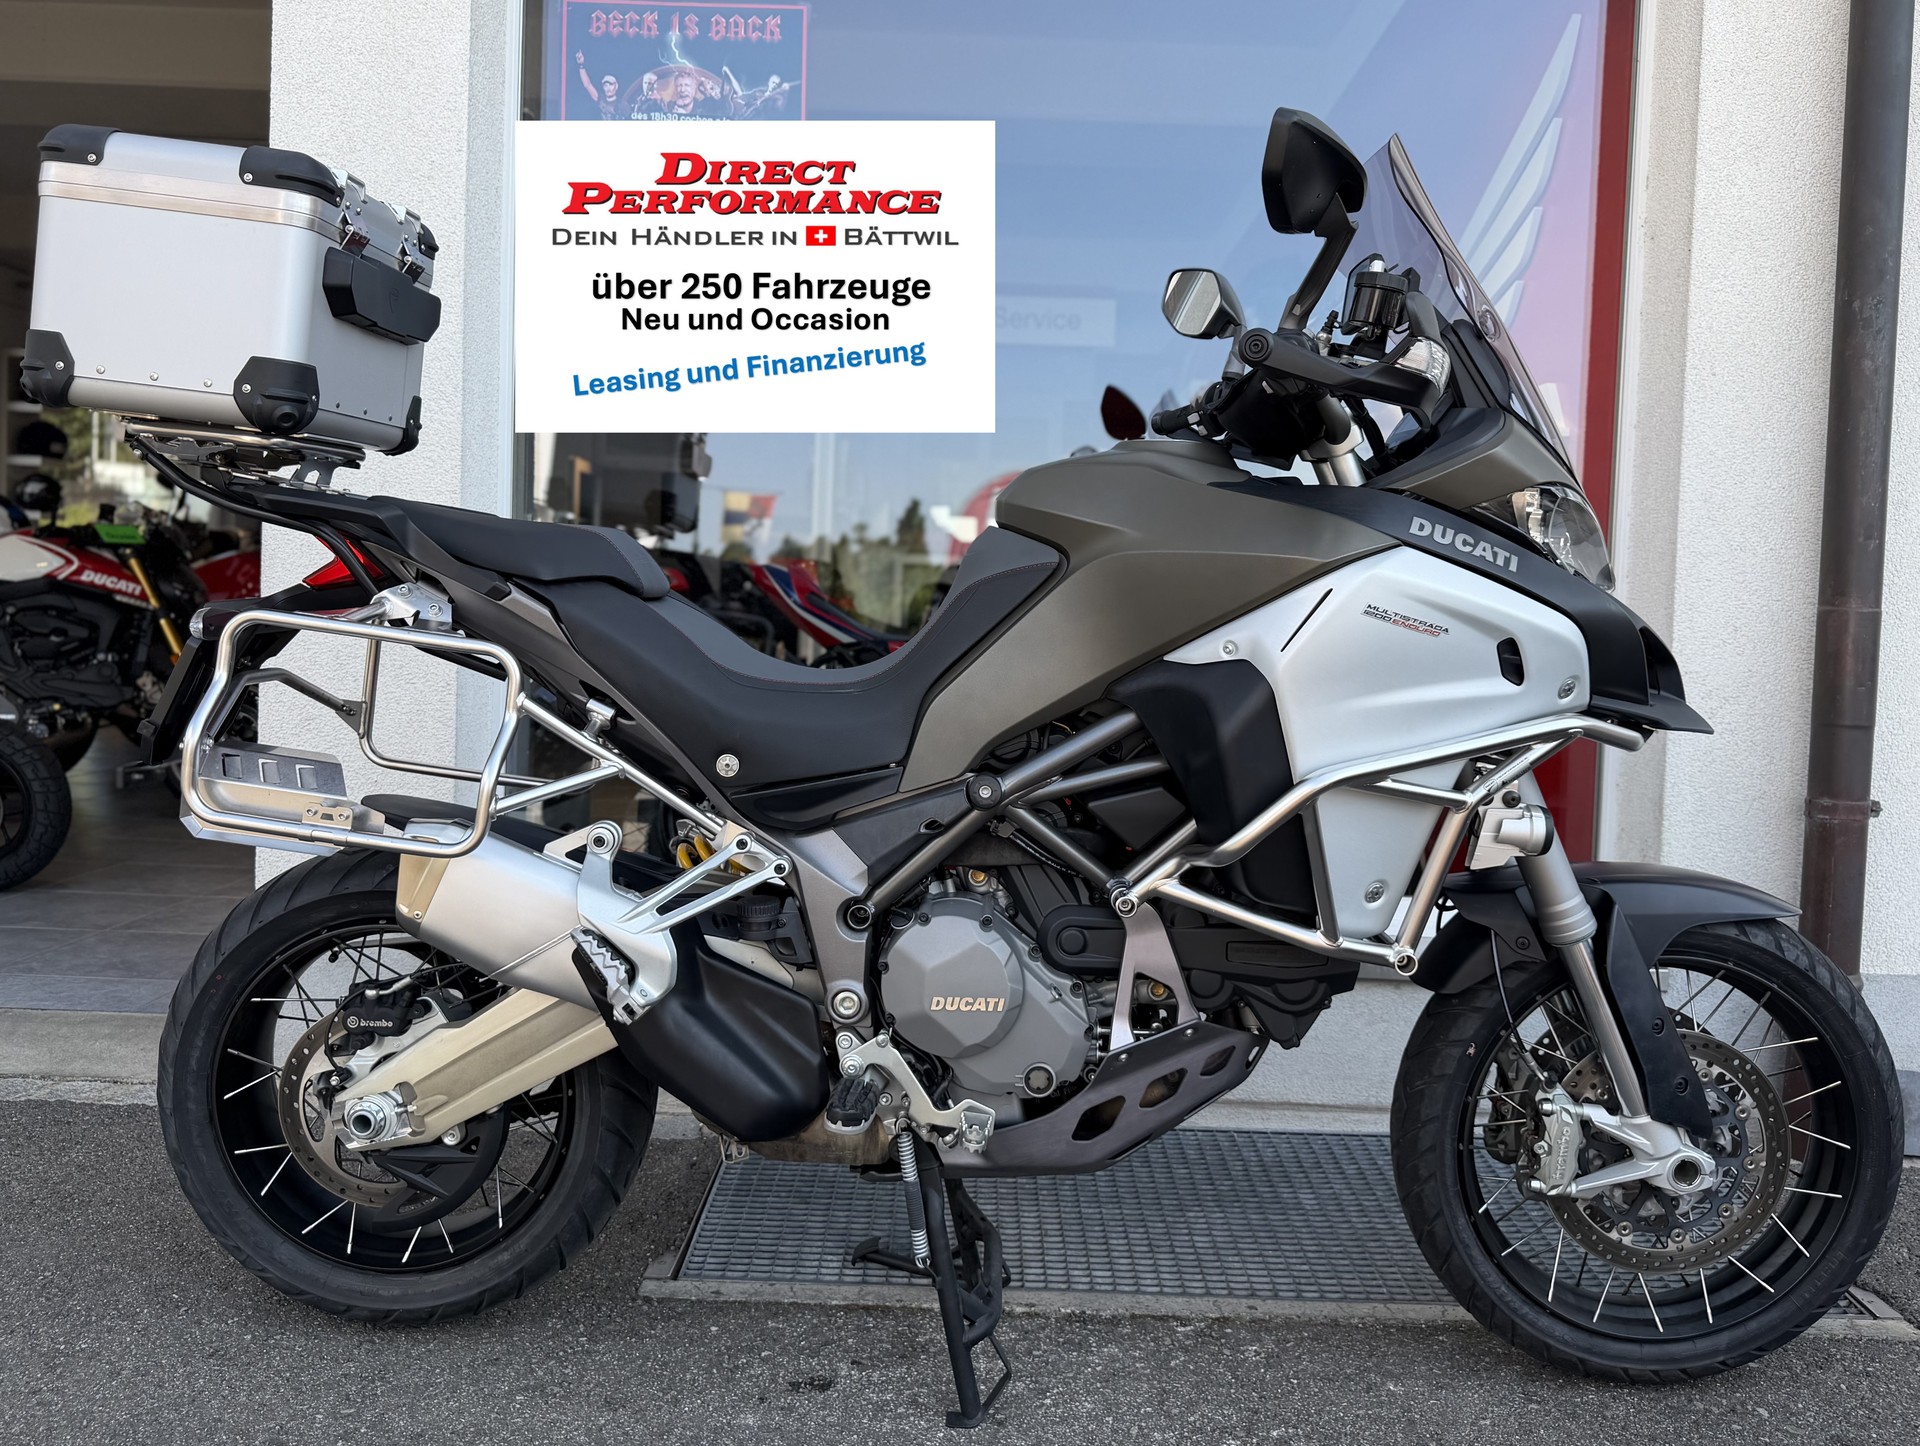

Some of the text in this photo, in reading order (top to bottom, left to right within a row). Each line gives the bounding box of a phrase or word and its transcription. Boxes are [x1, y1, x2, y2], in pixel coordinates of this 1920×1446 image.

[589, 9, 782, 41] BECK IS BACK
[1409, 516, 1519, 573] DUCATI
[81, 569, 142, 596] DUCATI
[1366, 603, 1450, 633] MULTISTRADA
[930, 996, 1006, 1012] DUCATI
[360, 1018, 393, 1027] brembo
